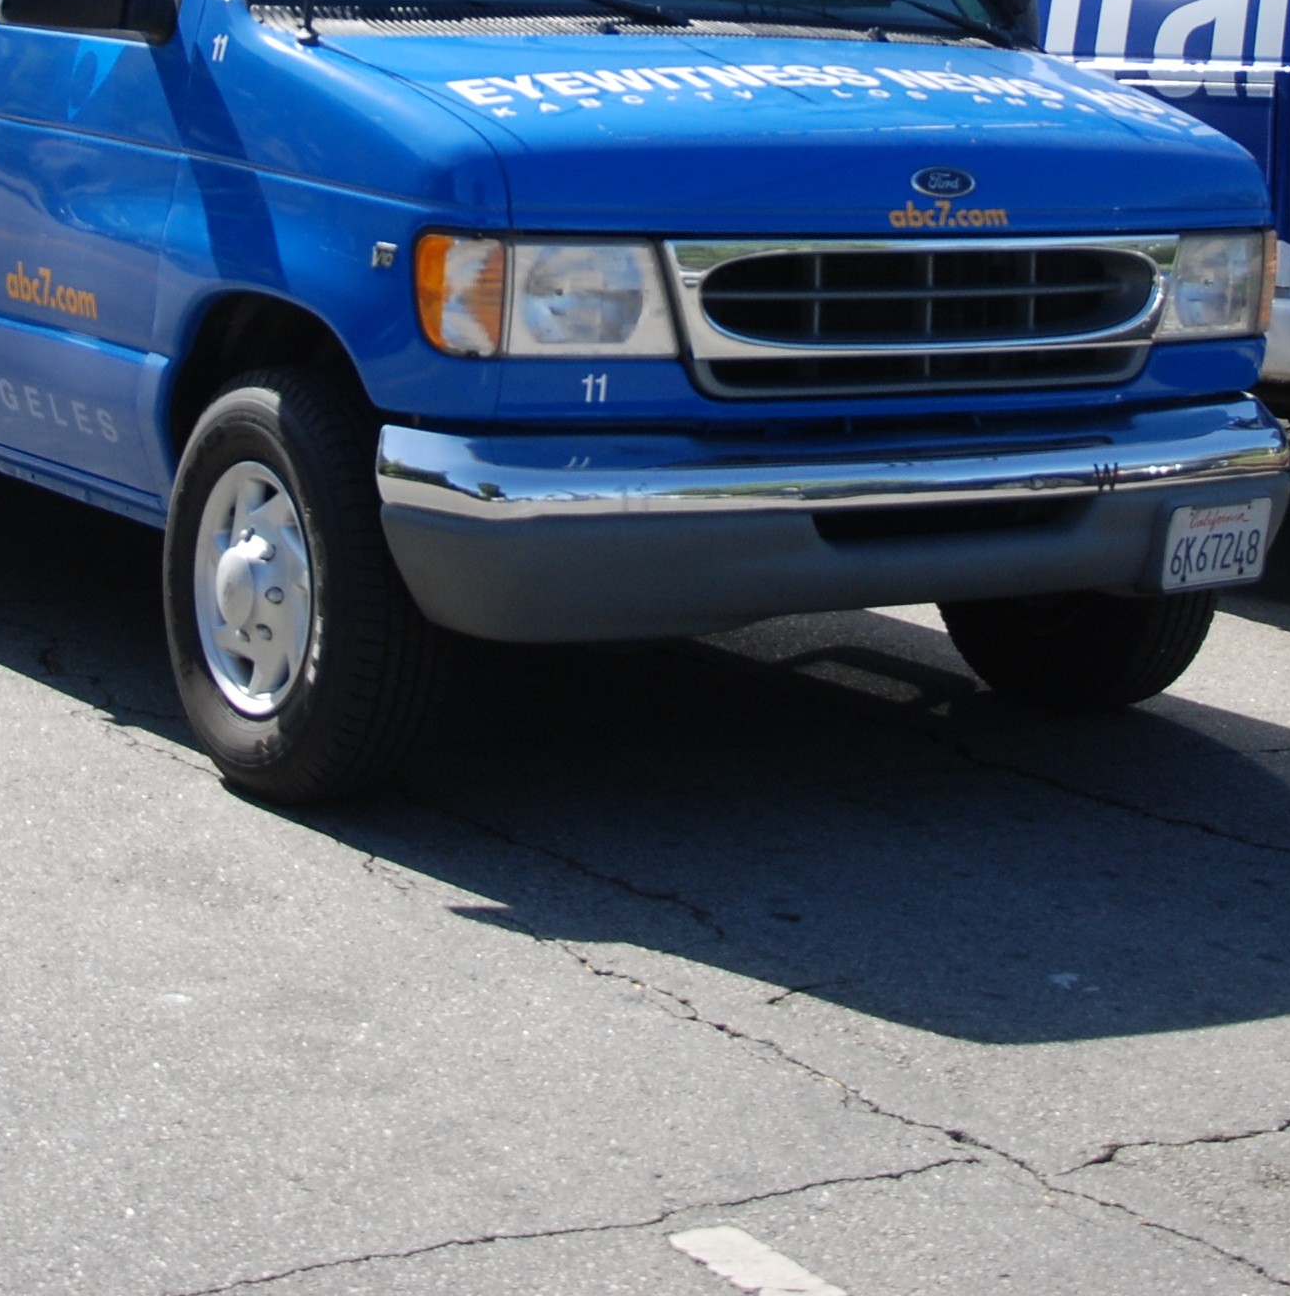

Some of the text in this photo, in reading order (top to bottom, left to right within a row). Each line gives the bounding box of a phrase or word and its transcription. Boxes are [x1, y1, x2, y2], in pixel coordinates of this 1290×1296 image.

[212, 34, 229, 62] 11
[446, 64, 881, 105] EYEWITNESS
[873, 67, 1066, 100] NEWS
[928, 172, 960, 189] Ford
[889, 200, 1008, 228] abc7.com
[6, 260, 98, 320] abc7.com
[581, 373, 608, 403] 11
[1189, 508, 1251, 532] California
[1170, 528, 1261, 576] 6K67248
